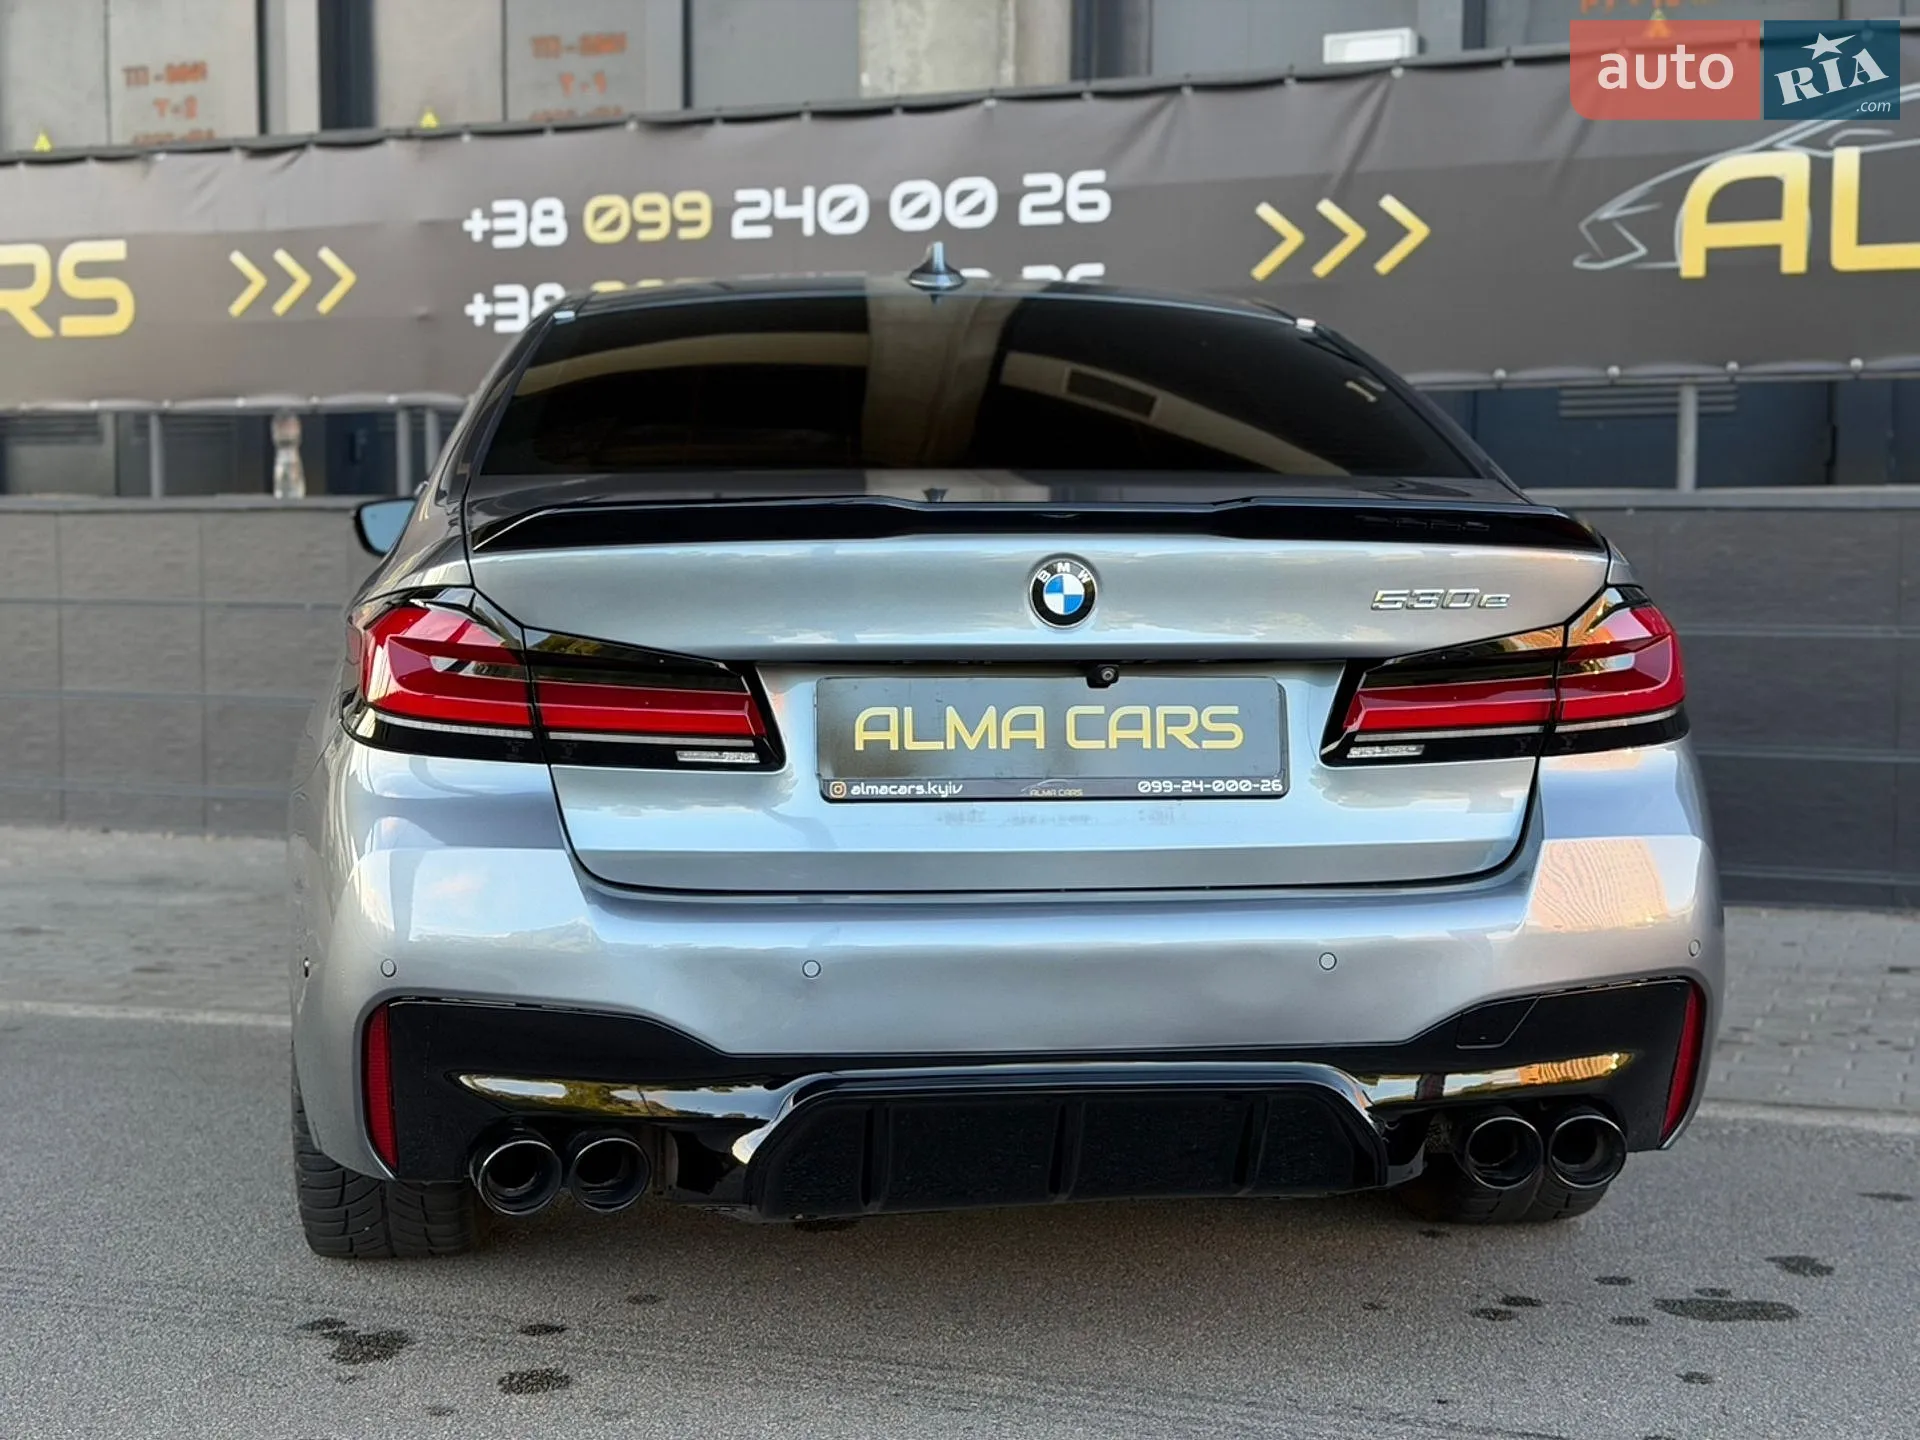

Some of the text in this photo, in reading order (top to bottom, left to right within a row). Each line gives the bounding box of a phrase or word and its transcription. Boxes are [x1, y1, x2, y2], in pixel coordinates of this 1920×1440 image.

[463, 169, 1111, 249] +38 099 240 00 26
[0, 239, 135, 338] RS
[1371, 588, 1510, 610] 530e
[854, 705, 1244, 751] ALMA CARS
[850, 781, 963, 797] almacars.kyiv
[1137, 779, 1283, 793] 099-24-000-26
